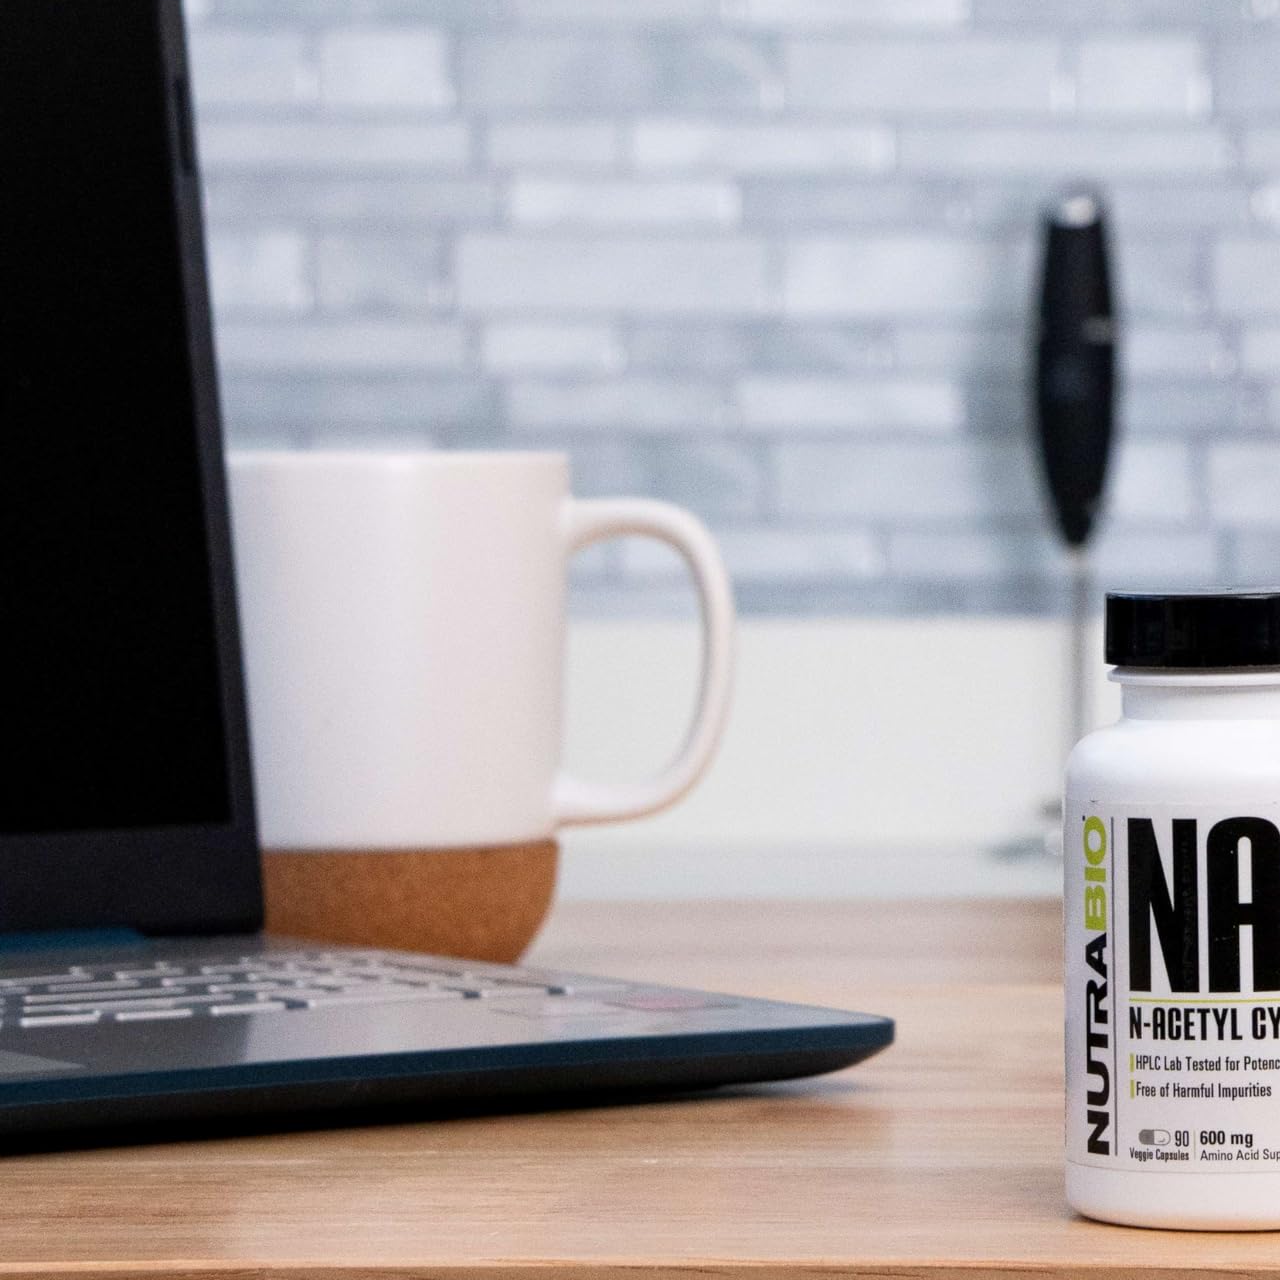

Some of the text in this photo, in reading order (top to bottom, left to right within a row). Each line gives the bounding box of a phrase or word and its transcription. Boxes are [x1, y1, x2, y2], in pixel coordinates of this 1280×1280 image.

[1083, 815, 1110, 1156] NUTRABIO
[1129, 1006, 1243, 1041] N-ACETYL
[1135, 1054, 1161, 1071] HPLC
[1163, 1055, 1182, 1071] Lab
[1185, 1056, 1221, 1071] Tested
[1225, 1056, 1240, 1071] for
[1135, 1081, 1272, 1101] Free of Harmful Impurities
[1174, 1130, 1190, 1147] 90
[1199, 1130, 1254, 1148] 600 mg
[1129, 1147, 1190, 1162] Veggie Capsules
[1200, 1149, 1234, 1161] Amino
[1235, 1148, 1260, 1161] Acid
